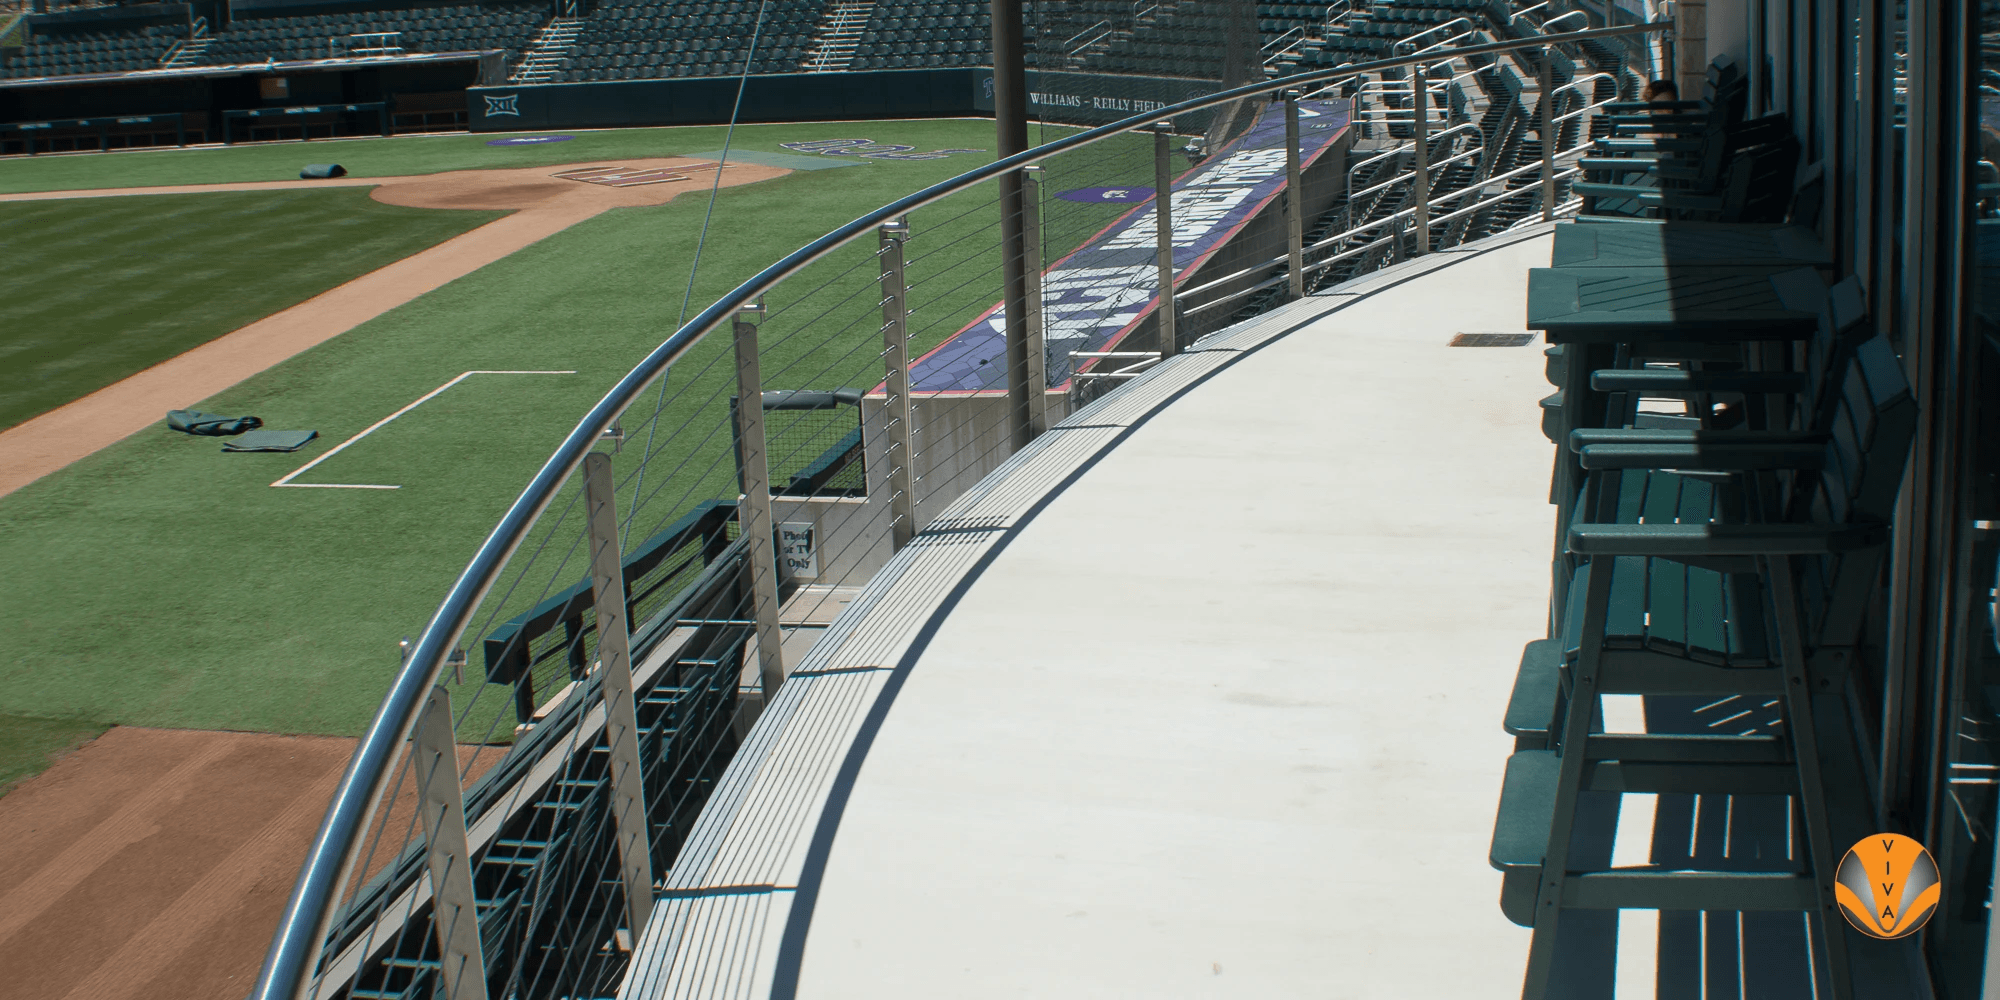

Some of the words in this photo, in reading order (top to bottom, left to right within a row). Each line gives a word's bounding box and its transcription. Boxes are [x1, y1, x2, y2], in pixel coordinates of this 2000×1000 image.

[488, 97, 515, 113] XII
[1030, 92, 1081, 107] WILLIAMS
[1093, 96, 1130, 111] REILLY
[1133, 99, 1166, 112] FIELD
[787, 557, 811, 569] Only
